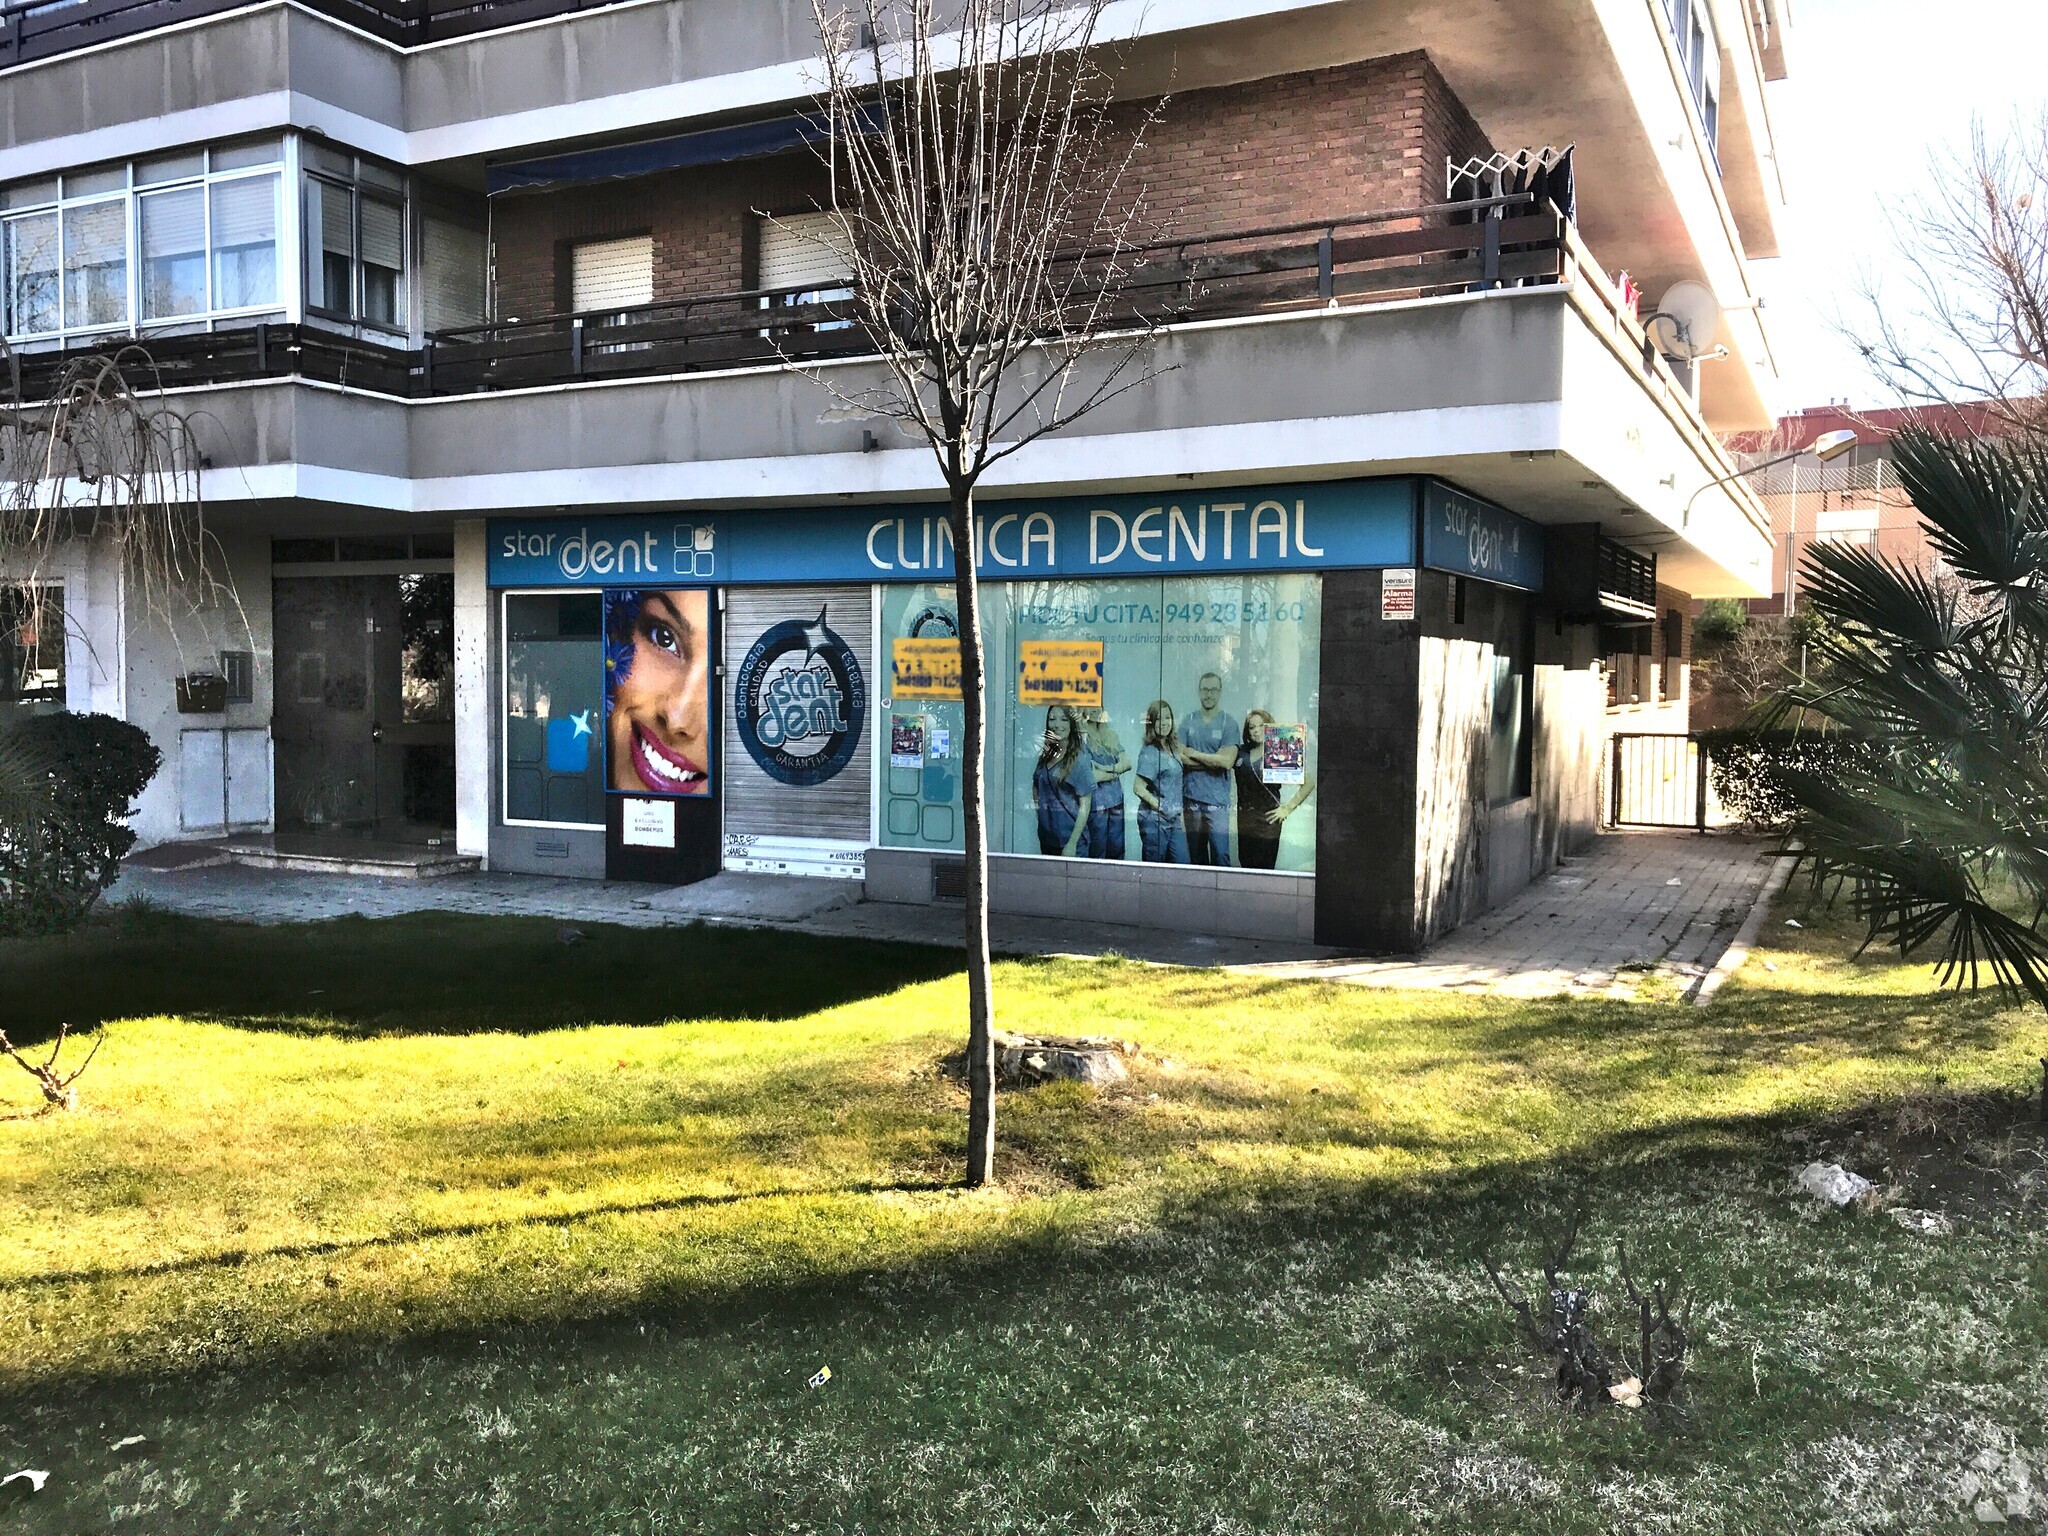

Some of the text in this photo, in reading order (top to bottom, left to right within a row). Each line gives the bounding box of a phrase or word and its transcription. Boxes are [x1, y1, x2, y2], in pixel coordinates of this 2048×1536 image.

[503, 527, 658, 577] star dent
[866, 500, 1324, 569] CLINICA DENTAL
[1445, 497, 1503, 571] star dent
[1103, 603, 1160, 624] CITA:
[1165, 603, 1205, 623] 949
[1211, 602, 1237, 623] 23
[1275, 602, 1304, 622] 60
[1118, 634, 1128, 643] tu
[1162, 633, 1173, 643] de
[750, 660, 767, 706] CALIDAD
[772, 667, 830, 705] star
[757, 687, 847, 748] dent
